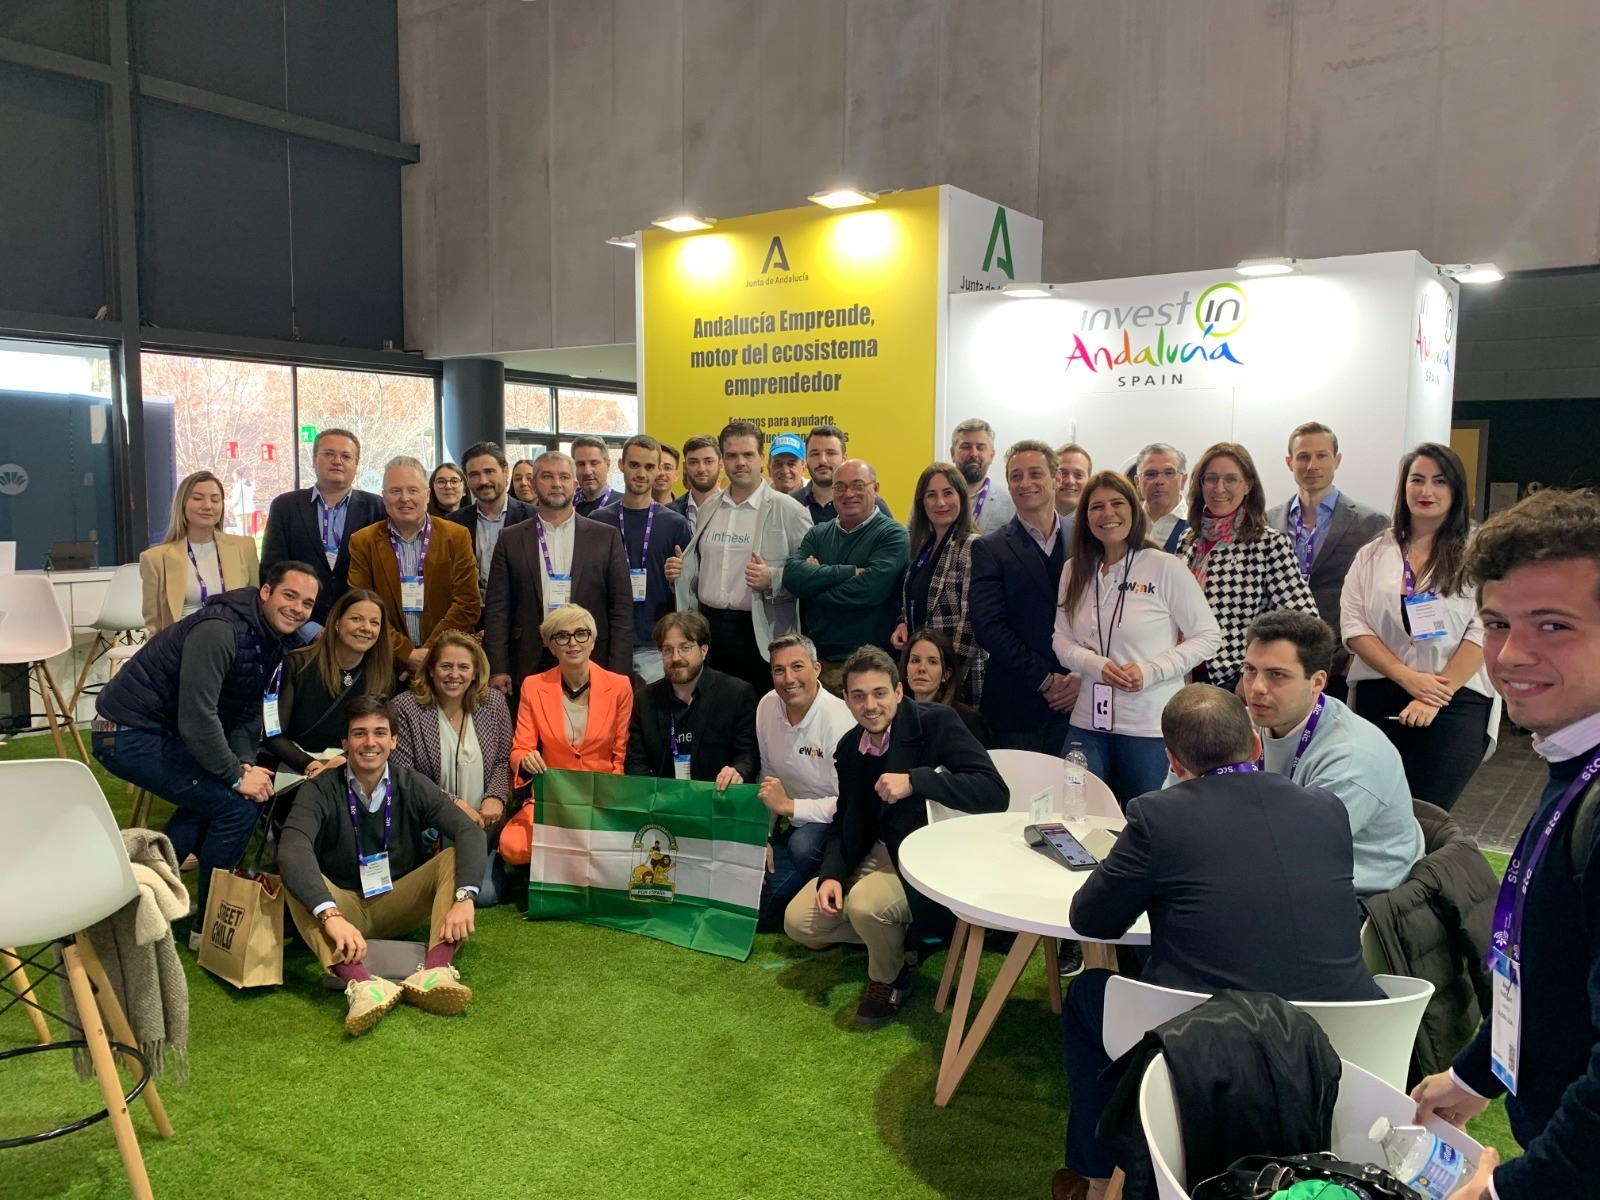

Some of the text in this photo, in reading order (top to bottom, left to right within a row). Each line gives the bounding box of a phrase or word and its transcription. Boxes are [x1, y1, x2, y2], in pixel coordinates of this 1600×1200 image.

[745, 272, 809, 288] Junta de Andalucía
[693, 303, 875, 339] Andalucía Emprende,
[1080, 290, 1241, 332] invest in
[690, 338, 878, 369] motor del ecosistema
[1064, 323, 1246, 374] Andalucía
[724, 370, 842, 398] emprendedor
[1117, 373, 1184, 388] SPAIN
[767, 416, 789, 429] para
[791, 414, 837, 428] ayudarte.
[1544, 810, 1561, 836] stc
[1507, 858, 1521, 884] stc
[1522, 868, 1533, 895] stc
